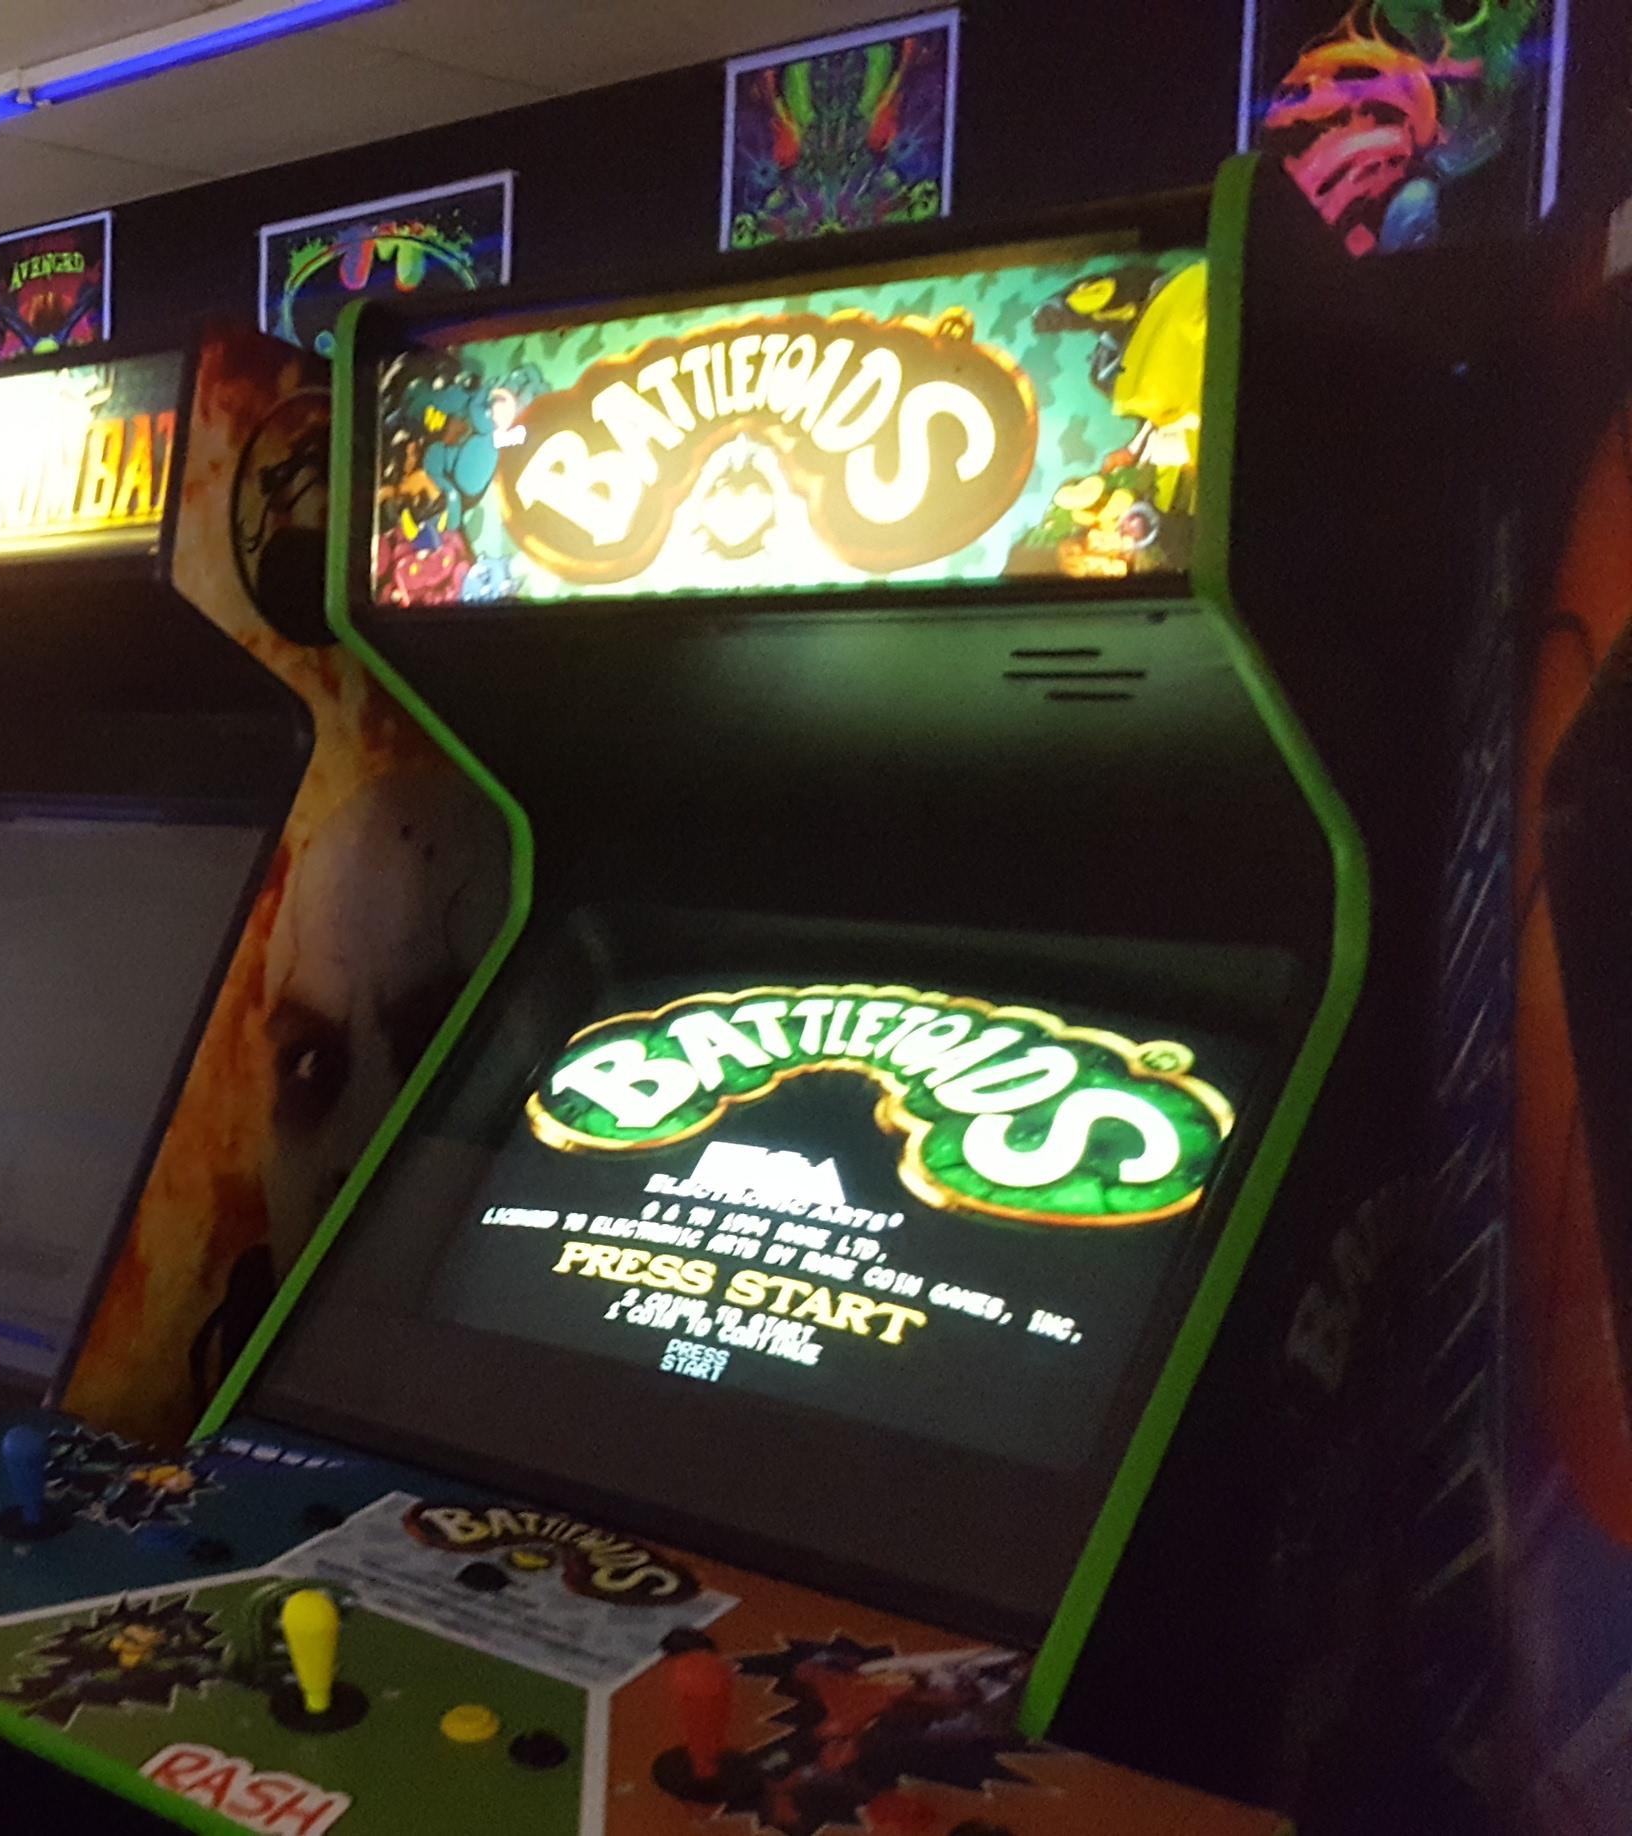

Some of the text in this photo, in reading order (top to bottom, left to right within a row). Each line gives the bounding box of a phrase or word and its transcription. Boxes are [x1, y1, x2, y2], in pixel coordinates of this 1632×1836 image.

[515, 334, 996, 546] BATTLETOADS
[551, 999, 1180, 1187] BATTLETOADS
[552, 1241, 928, 1344] PRESS START
[863, 1265, 924, 1298] COIN
[660, 1353, 724, 1383] START
[665, 1338, 730, 1367] PRESS
[146, 1747, 344, 1836] RASH
